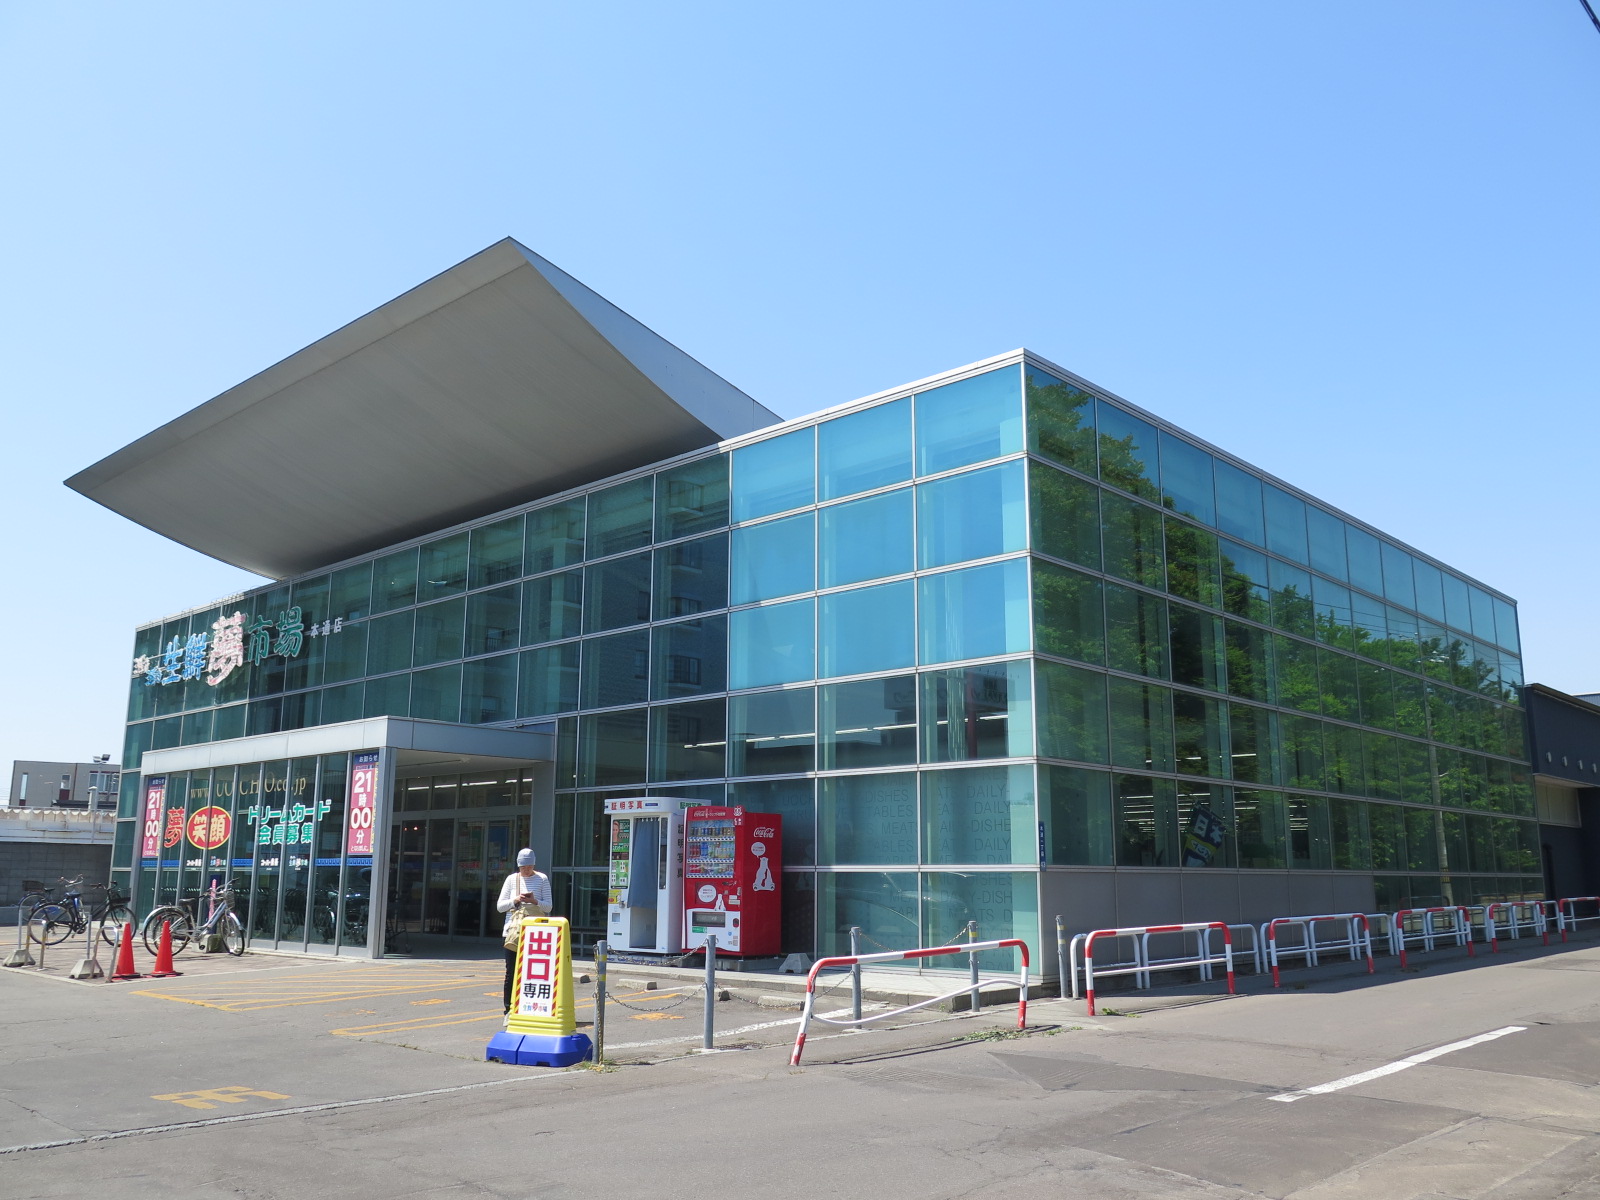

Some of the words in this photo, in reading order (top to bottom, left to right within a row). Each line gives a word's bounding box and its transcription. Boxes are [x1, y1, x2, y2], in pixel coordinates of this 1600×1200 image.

[310, 616, 343, 638] 本通店
[353, 771, 372, 794] 21
[148, 791, 161, 810] 21
[611, 801, 643, 810] 証明写真
[247, 799, 332, 825] ドリームカード
[350, 807, 371, 829] 00
[164, 806, 186, 848] 夢
[192, 814, 226, 843] 笑顔
[257, 822, 313, 845] 会員募集
[527, 931, 552, 981] 出口
[523, 983, 551, 1000] 専用
